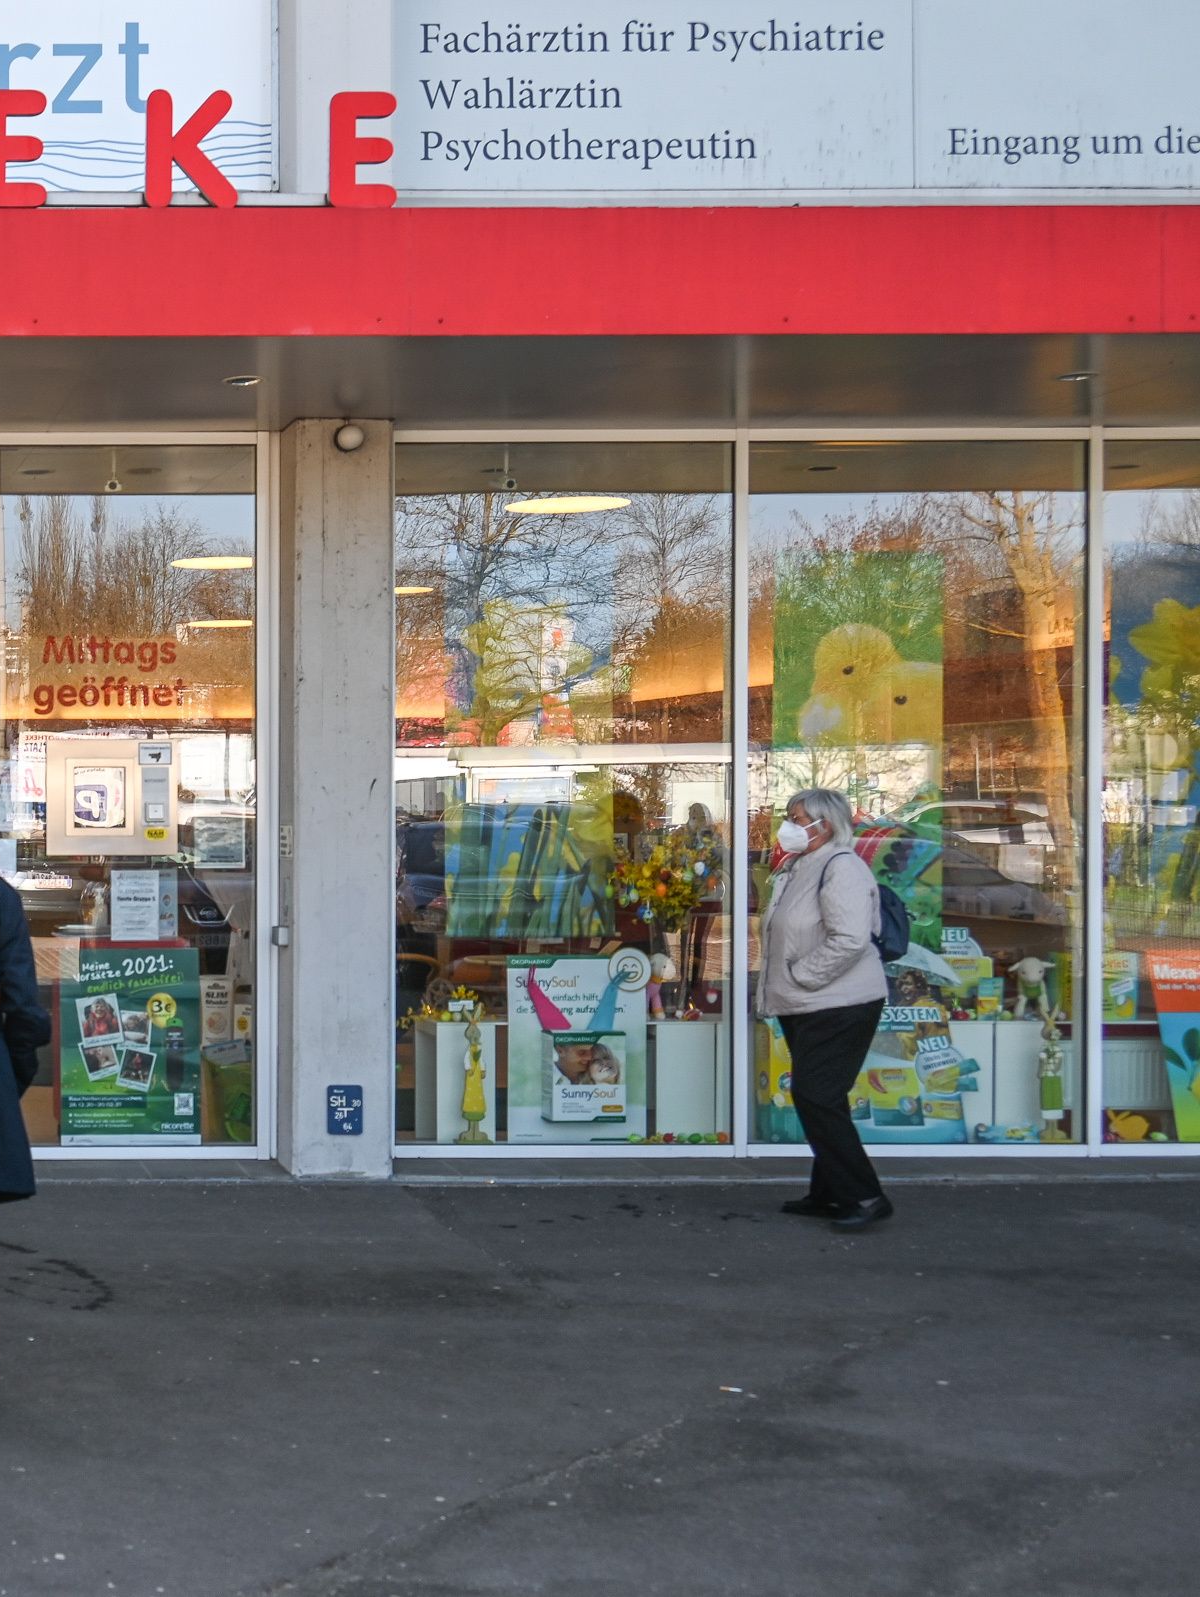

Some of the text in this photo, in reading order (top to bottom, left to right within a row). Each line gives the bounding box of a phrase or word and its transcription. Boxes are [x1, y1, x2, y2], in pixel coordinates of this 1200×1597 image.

[420, 20, 885, 61] Fachärztin für Psychiatrie
[420, 76, 622, 109] Wahlärztin
[420, 127, 757, 168] Psychotherapeutin
[948, 124, 1200, 163] Eingang um die
[43, 635, 177, 672] Mittags
[33, 676, 187, 715] geöffnet
[122, 954, 174, 976] 2021:
[882, 1007, 939, 1020] SYSTEM
[917, 1035, 949, 1053] NEU
[330, 1095, 346, 1107] SH
